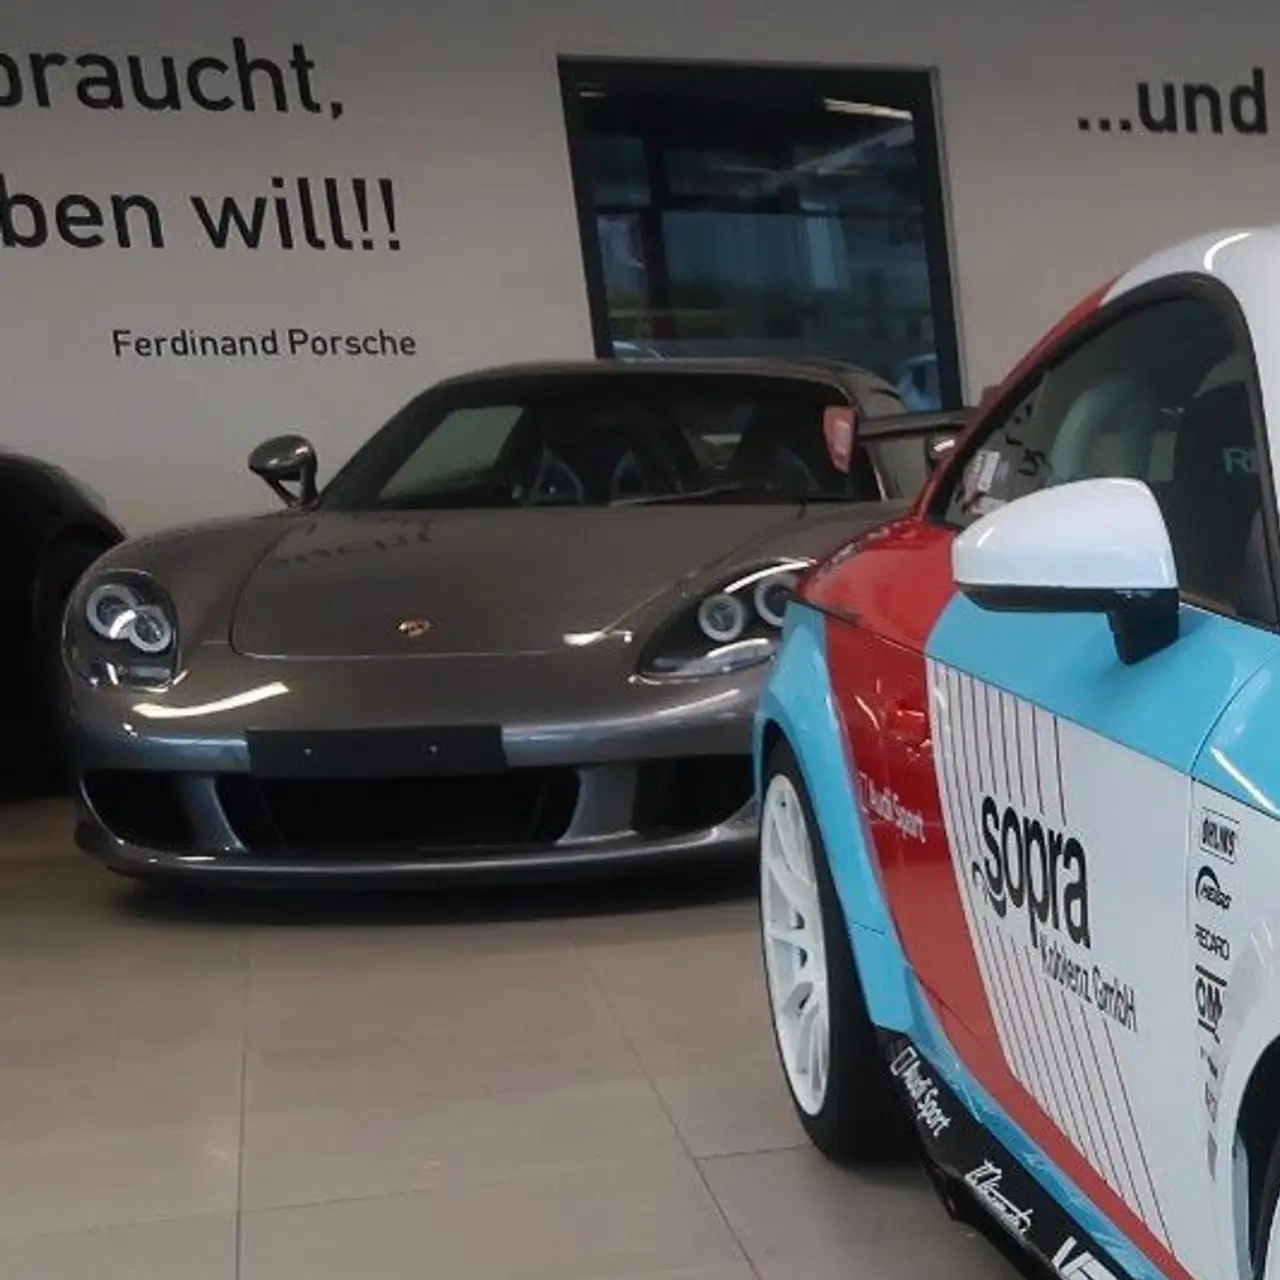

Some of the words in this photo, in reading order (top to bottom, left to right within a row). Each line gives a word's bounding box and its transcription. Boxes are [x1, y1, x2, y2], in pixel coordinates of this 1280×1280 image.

[1077, 66, 1268, 134] ...und
[190, 176, 402, 250] will!!
[112, 328, 280, 358] Ferdinand
[288, 329, 418, 357] Porsche
[980, 796, 1091, 949] sopra
[916, 1087, 952, 1138] Sport
